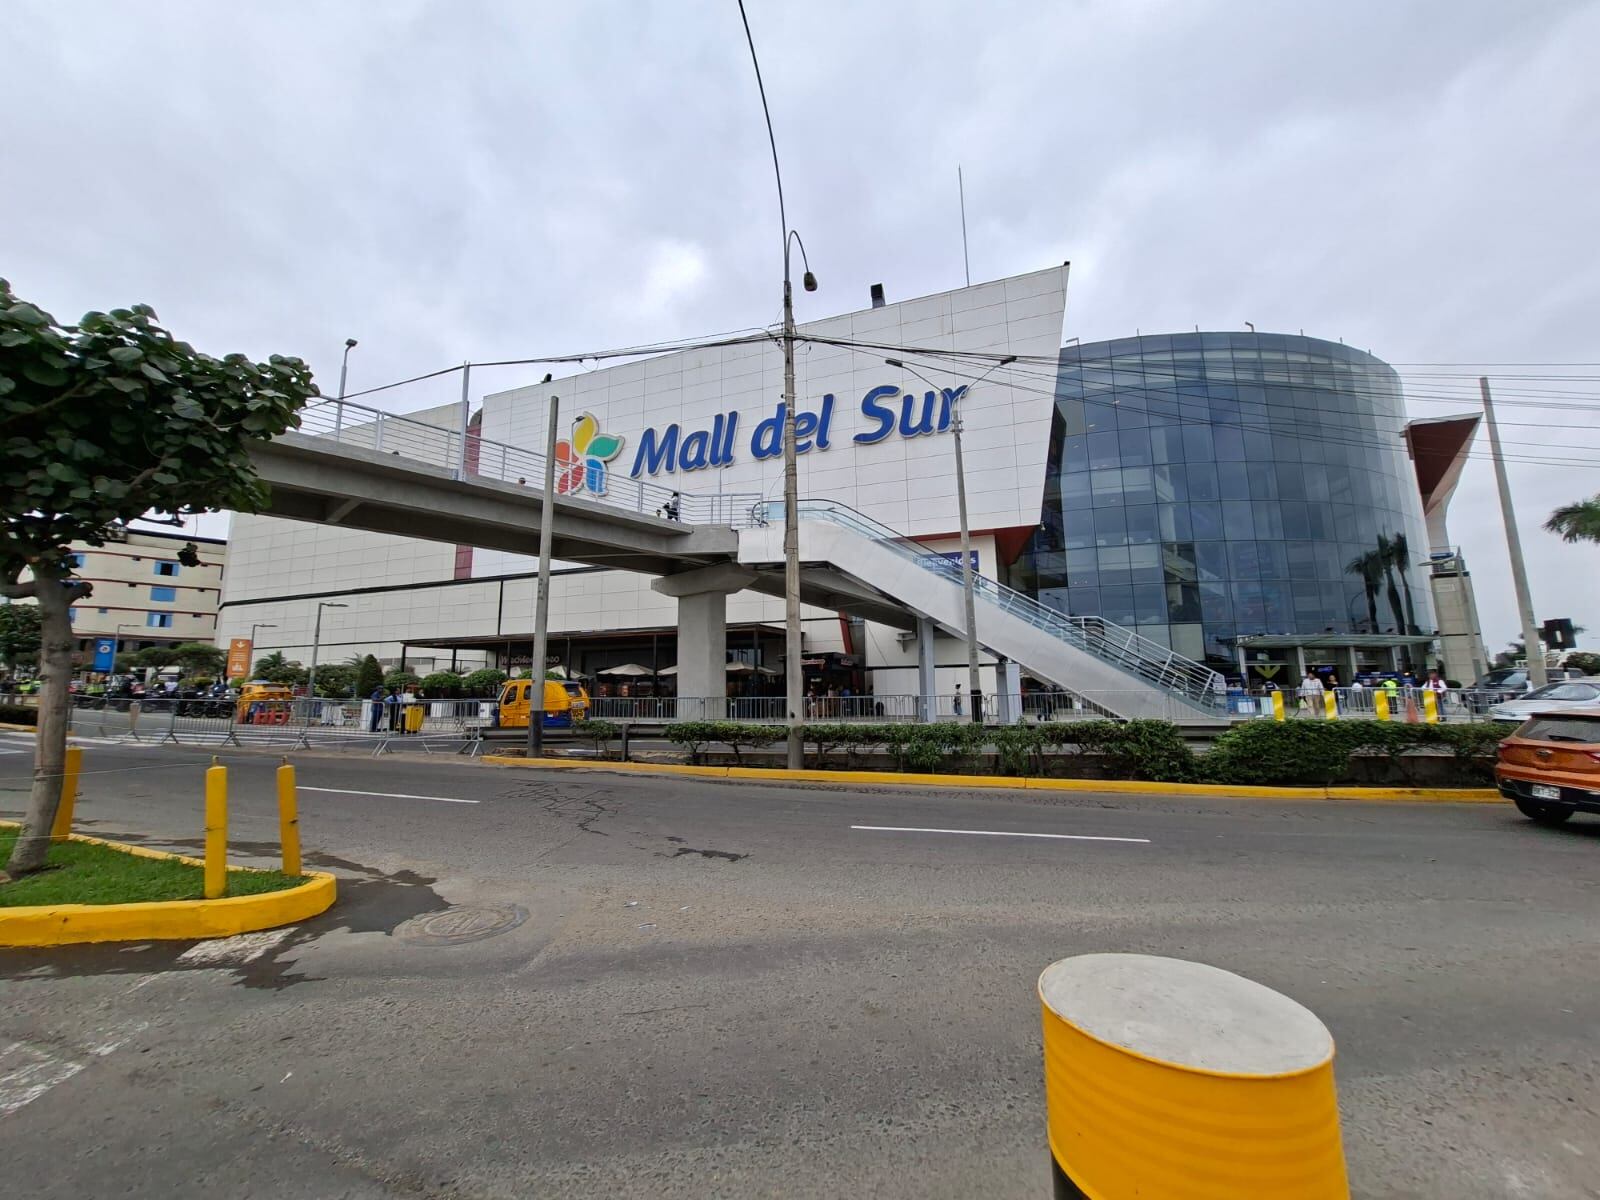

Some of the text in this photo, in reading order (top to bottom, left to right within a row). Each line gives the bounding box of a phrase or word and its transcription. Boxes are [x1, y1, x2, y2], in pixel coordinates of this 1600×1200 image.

[631, 384, 969, 480] Mall del Sur
[917, 556, 976, 569] ienvenids
